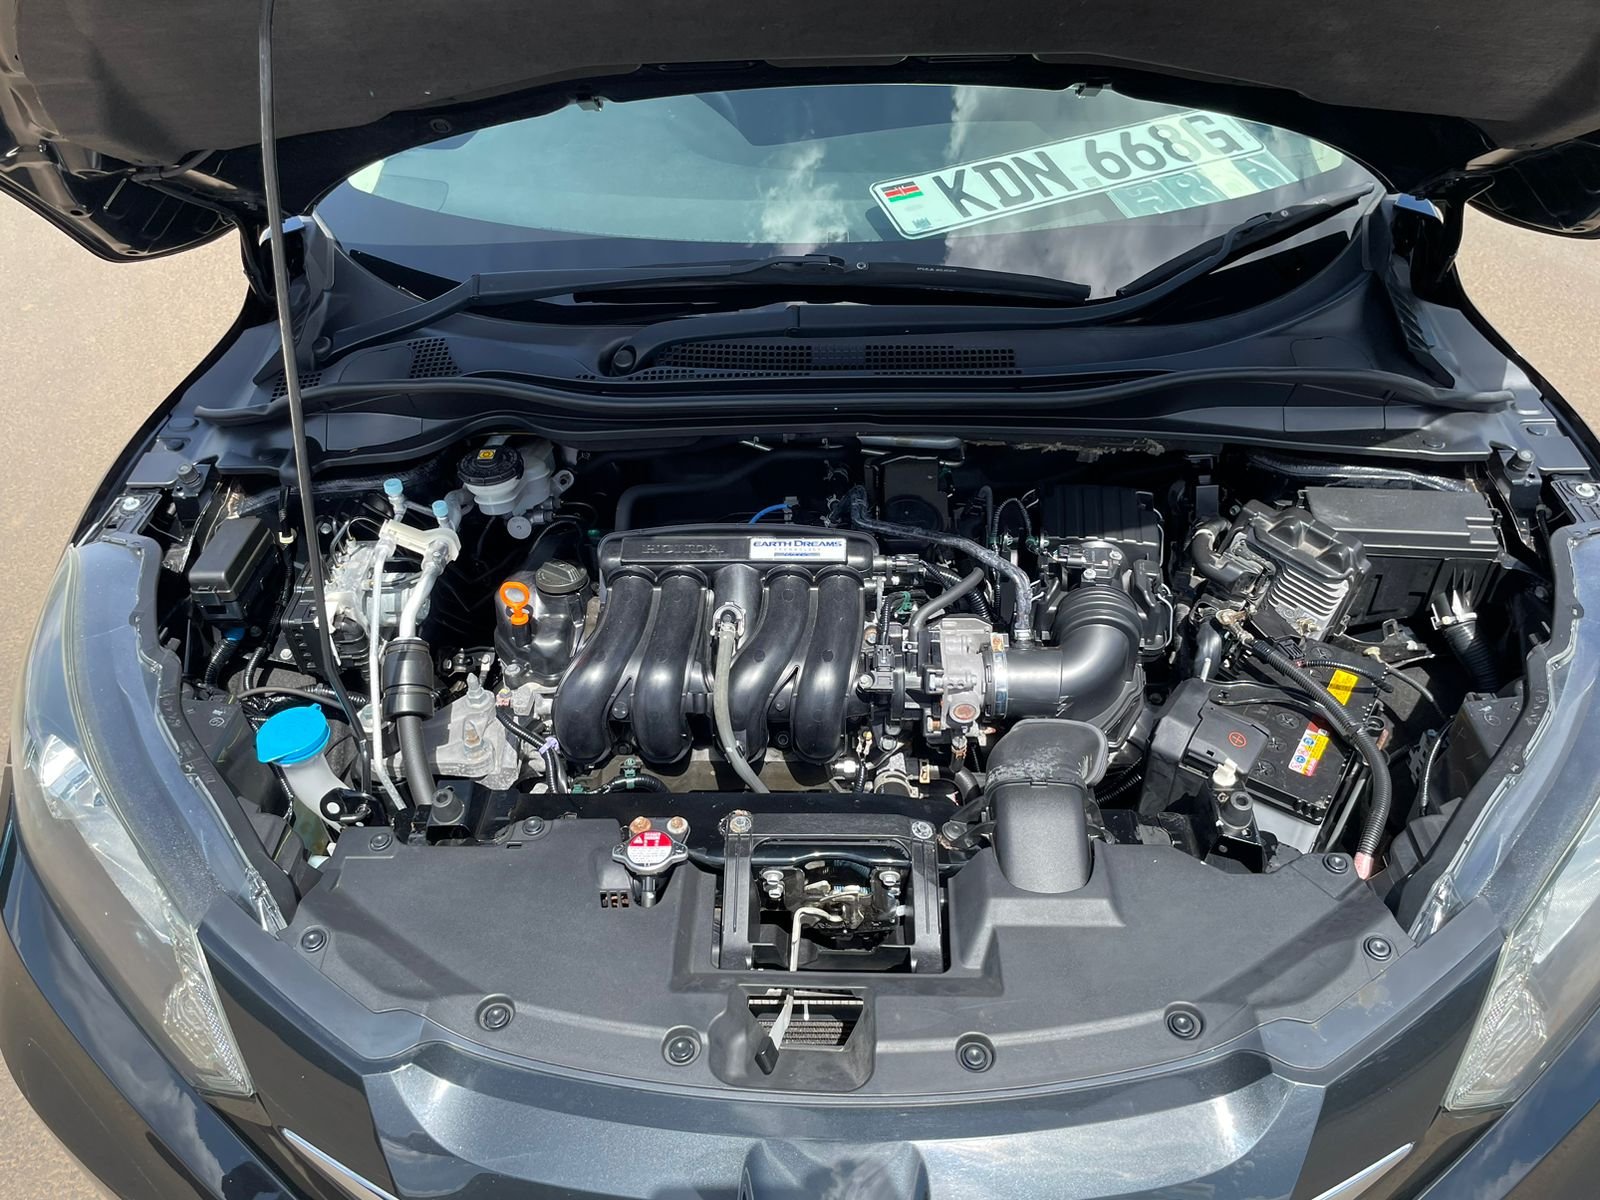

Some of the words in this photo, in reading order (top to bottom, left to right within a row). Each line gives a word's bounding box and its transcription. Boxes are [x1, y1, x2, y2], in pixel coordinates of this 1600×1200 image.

[932, 151, 1079, 217] KDN
[1085, 114, 1245, 180] 668G
[794, 539, 842, 547] DREAMS
